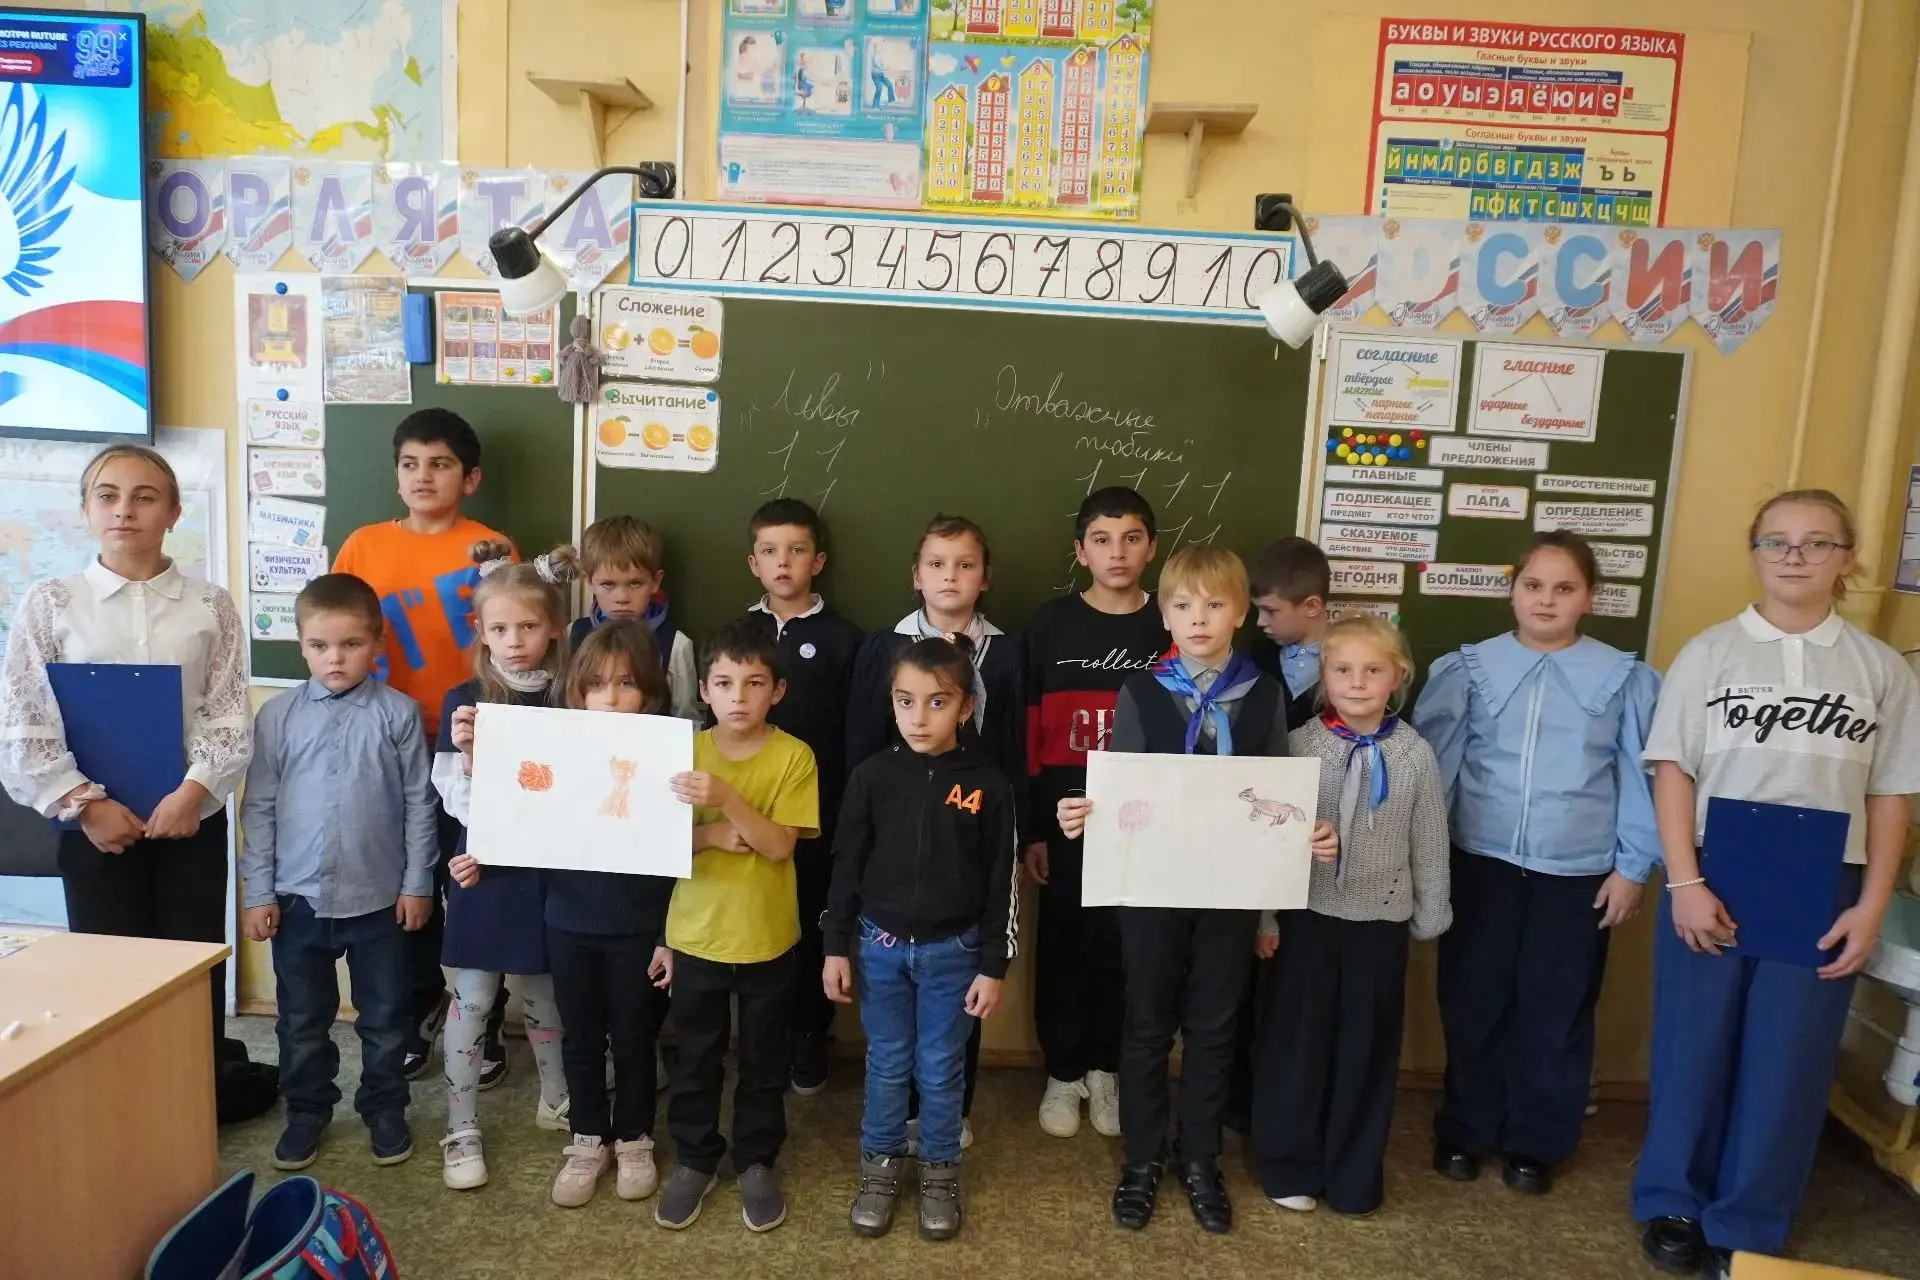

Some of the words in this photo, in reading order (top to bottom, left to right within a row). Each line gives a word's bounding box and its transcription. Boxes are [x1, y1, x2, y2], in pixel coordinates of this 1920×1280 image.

[31, 31, 68, 41] RUTUBE
[1388, 24, 1448, 40] БУКВЫ
[1452, 26, 1465, 42] И
[1469, 27, 1524, 46] ЗВУКИ
[1528, 31, 1616, 50] РУССКОГО
[1620, 35, 1677, 54] ЯЗЫКА
[9, 40, 57, 50] РЕКЛАМЫ
[1476, 50, 1514, 60] Гласные
[1518, 54, 1546, 64] буквы
[1560, 58, 1587, 68] звуки
[990, 79, 998, 88] 7
[1396, 82, 1410, 100] а
[1418, 82, 1434, 100] о
[1442, 84, 1458, 107] у
[1462, 85, 1482, 103] ы
[1486, 86, 1500, 104] э
[1509, 88, 1524, 106] я
[1532, 84, 1548, 107] ё
[1552, 90, 1574, 108] ю
[1578, 91, 1594, 108] и
[1602, 92, 1616, 110] е
[1466, 128, 1514, 140] Согласные
[1518, 131, 1548, 142] буквы
[1560, 136, 1588, 144] звуки
[1388, 147, 1400, 168] й
[1406, 153, 1418, 170] н
[1422, 154, 1438, 170] м
[1440, 154, 1454, 172] л
[1458, 156, 1472, 178] р
[1476, 152, 1489, 174] б
[1494, 158, 1506, 175] в
[1512, 160, 1524, 176] г
[1528, 160, 1542, 180] д
[1548, 161, 1560, 178] з
[1564, 162, 1582, 178] ж
[157, 168, 614, 250] ОРЛЯТА
[1472, 196, 1485, 212] п
[1488, 192, 1505, 218] ф
[1508, 198, 1520, 214] к
[1527, 198, 1538, 214] т
[1545, 200, 1556, 216] с
[1560, 201, 1577, 218] ш
[1580, 202, 1593, 218] х
[1598, 204, 1610, 222] ц
[1616, 204, 1628, 220] ч
[1632, 205, 1648, 224] щ
[654, 216, 690, 278] 0
[722, 220, 746, 280] 1
[759, 222, 799, 283] 2
[812, 224, 853, 285] 3
[876, 228, 906, 288] 4
[918, 230, 962, 290] 5
[974, 232, 1014, 294] 6
[1034, 236, 1070, 296] 7
[1086, 239, 1122, 300] 8
[1138, 242, 1178, 303] 9
[618, 296, 705, 318] Сложение
[1356, 348, 1440, 364] согласные
[1504, 358, 1576, 375] гласные
[1344, 371, 1394, 386] твёрдые
[996, 364, 1157, 428] Отважные
[1342, 386, 1385, 397] мягкие
[610, 388, 706, 410] Вычитание
[1372, 399, 1414, 410] парные
[1480, 400, 1528, 412] ударные
[266, 409, 308, 421] РУССКИЙ
[1364, 410, 1420, 422] непарные
[1521, 414, 1586, 429] безударные
[275, 422, 300, 430] ЯЗЫК
[768, 430, 800, 472] 1
[816, 437, 846, 472] 1
[1468, 442, 1512, 452] ЧЛЕНЫ
[1441, 454, 1535, 466] ПРЕДЛОЖЕНИЯ
[1352, 469, 1416, 481] ГЛАВНЫЕ
[1543, 478, 1650, 492] ВТОРОСТЕПЕННЫЕ
[1163, 472, 1190, 508] 1
[1203, 472, 1232, 516] 1
[1336, 492, 1432, 506] ПОДЛЕЖАЩЕЕ
[1466, 494, 1510, 508] ПАПА
[1330, 510, 1372, 518] ПРЕДМЕТ
[1546, 506, 1642, 518] ОПРЕДЕЛЕНИЕ
[260, 512, 316, 528] МАТЕМАТИКА
[1341, 528, 1418, 542] СКАЗУЕМОЕ
[1329, 544, 1372, 552] ДЕЙСТВИЕ
[264, 556, 311, 564] ФИЗИЧЕСКАЯ
[270, 567, 306, 575] КУЛЬТУРА
[1426, 573, 1512, 587] БОЛЬШУЮ
[262, 606, 296, 614] ОКРУЖА
[280, 616, 296, 624] МИ
[1707, 688, 1878, 744] together
[944, 784, 984, 814] A4
